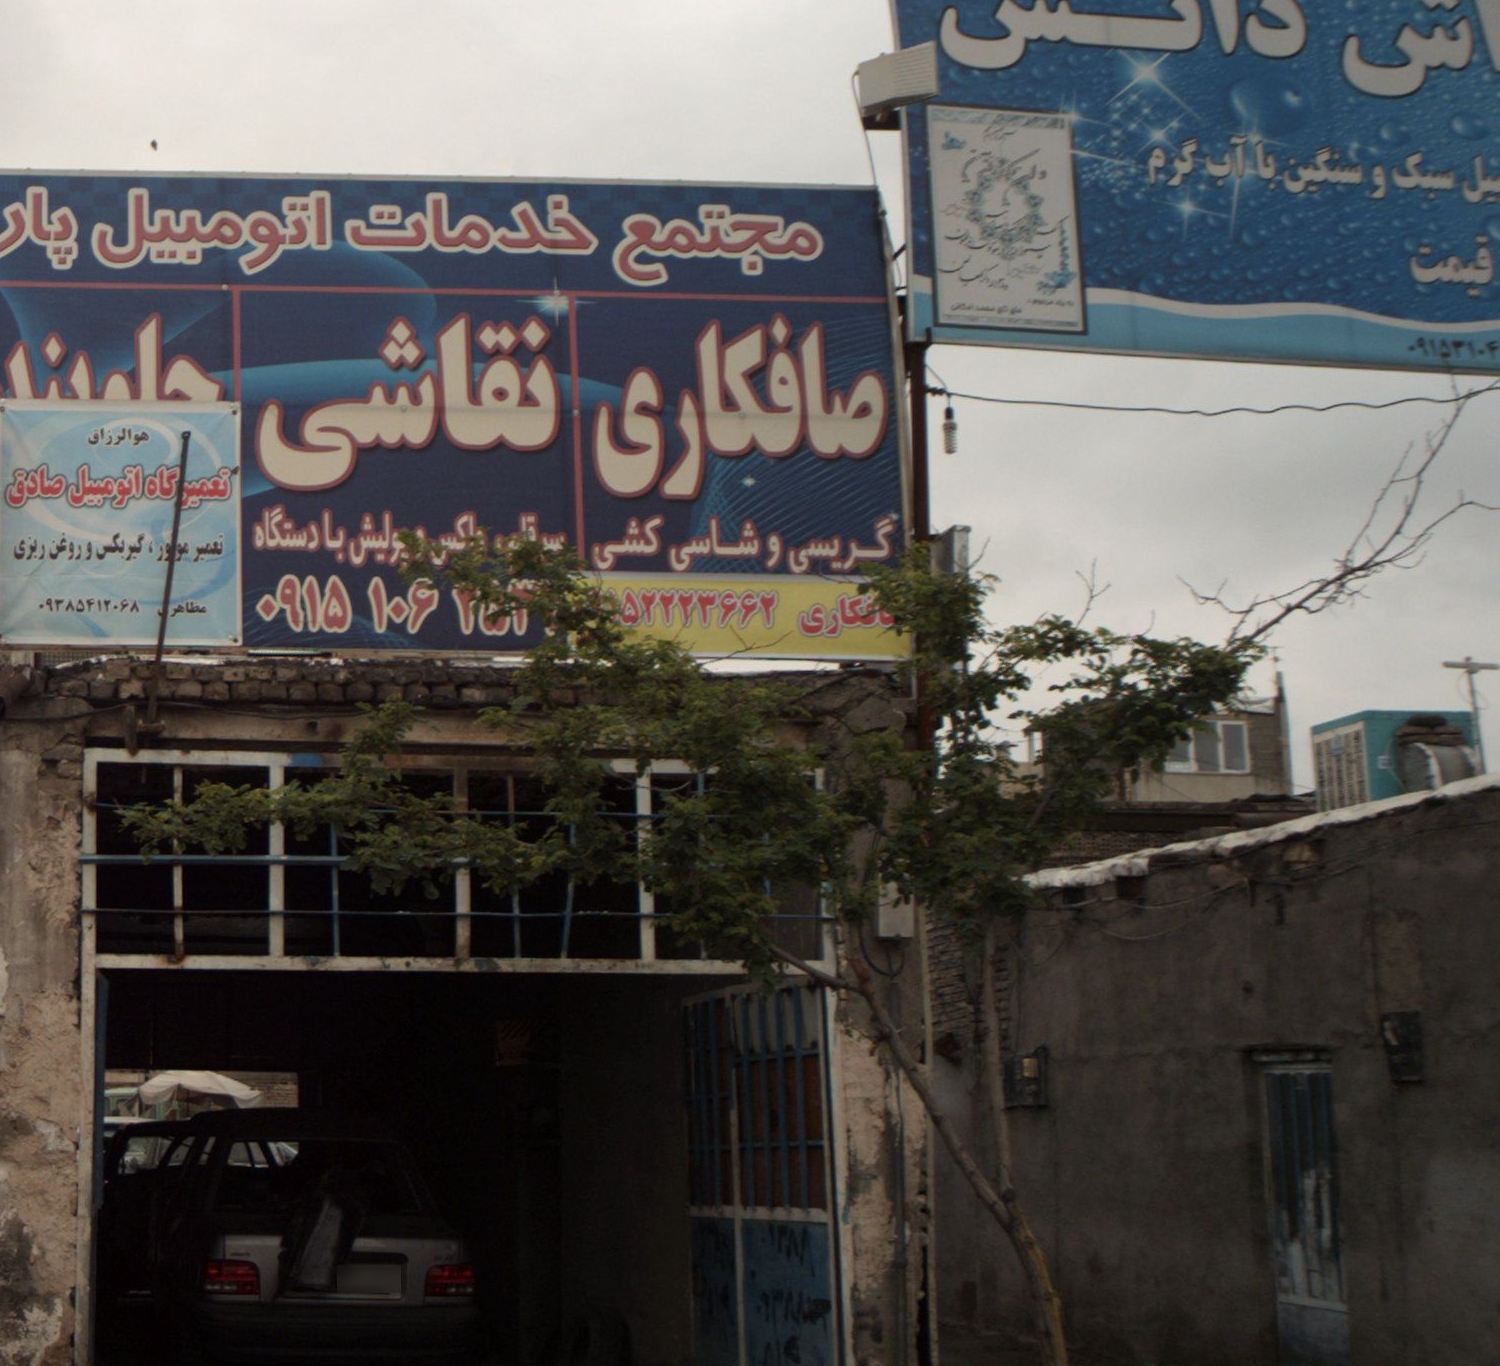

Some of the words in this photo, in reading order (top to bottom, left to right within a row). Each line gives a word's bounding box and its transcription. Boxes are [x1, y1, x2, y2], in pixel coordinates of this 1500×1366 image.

[1147, 138, 1198, 186] گرم
[1204, 134, 1247, 187] آب
[1254, 140, 1277, 190] با
[1282, 146, 1364, 195] سنگین
[1368, 164, 1387, 200] و
[1392, 151, 1456, 200] سبک
[92, 186, 330, 276] اتومبیل
[343, 190, 599, 255] خدمات
[612, 204, 823, 286] مجتمع
[1410, 235, 1495, 298] قیمت
[256, 312, 562, 493] نقاشی
[592, 313, 890, 501] صافکاری
[5, 463, 66, 509] صادق
[67, 463, 143, 509] اتومبیل
[13, 537, 46, 561] ریزی
[49, 533, 82, 560] روغن
[85, 540, 93, 561] و
[96, 532, 144, 562] گیربکس
[193, 534, 223, 562] تعمیر
[253, 504, 320, 550] دستگاه
[321, 508, 347, 563] با
[592, 514, 664, 572] کشی
[670, 515, 762, 572] شاسی
[156, 543, 189, 562] موور
[765, 531, 783, 572] و
[38, 597, 140, 614] ۰۹۳۸۵۴۱۲۰۶۸
[256, 573, 353, 633] ۰۹۱۵
[368, 575, 440, 634] ۱۰۶
[592, 588, 778, 628] ۵۲۲۲۳۶۶۲
[798, 592, 897, 638] افکاری
